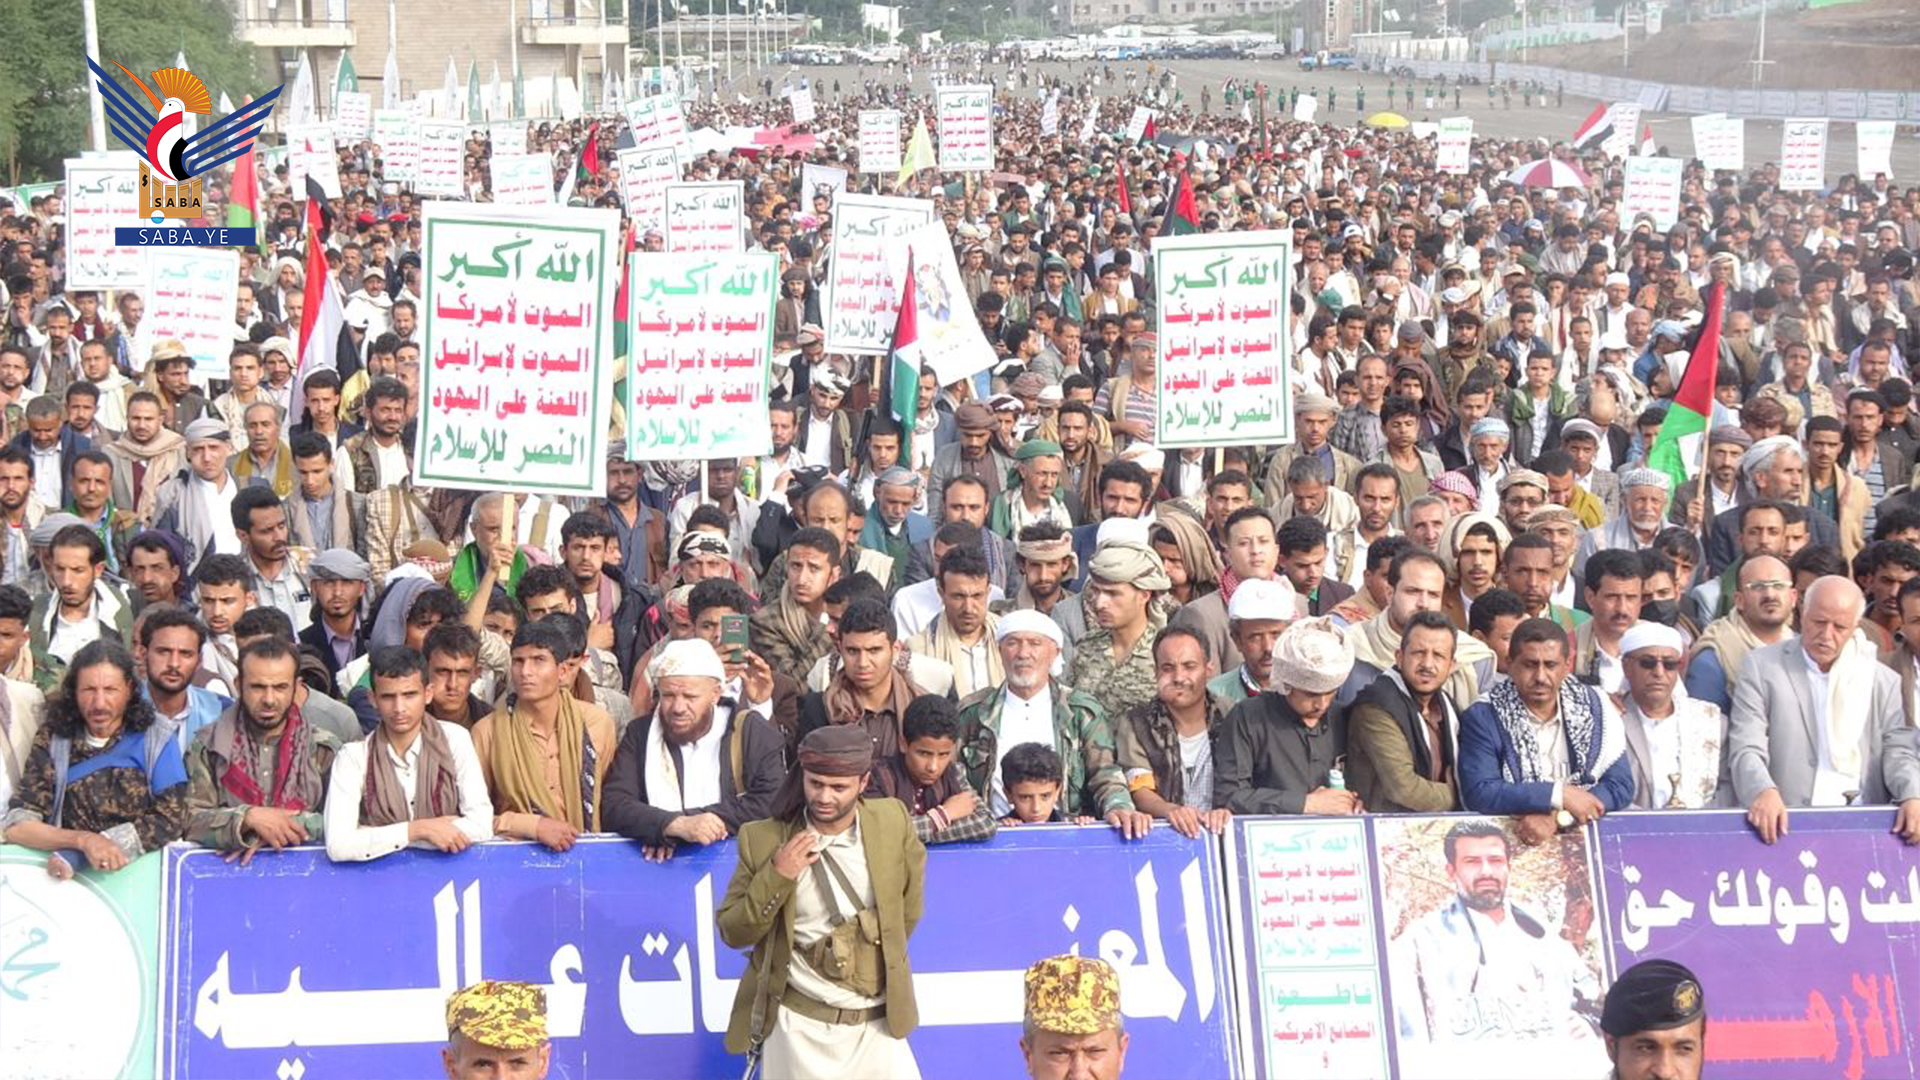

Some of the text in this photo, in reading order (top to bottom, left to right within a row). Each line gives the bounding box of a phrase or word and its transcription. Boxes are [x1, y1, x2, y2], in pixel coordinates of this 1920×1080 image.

[437, 230, 533, 289] أكبر
[1165, 252, 1234, 299] أكبر
[524, 302, 592, 332] الموت
[712, 311, 764, 336] الموت
[1231, 299, 1278, 324] الموت
[711, 347, 762, 372] الموت
[1231, 332, 1278, 357] الموت
[522, 347, 589, 377] الموت
[1212, 369, 1235, 393] على
[432, 384, 587, 420] اللعنة على اليهود
[690, 383, 714, 410] على
[514, 427, 584, 474] النصر
[1621, 865, 1695, 951] حق
[1709, 850, 1850, 945] وقولك
